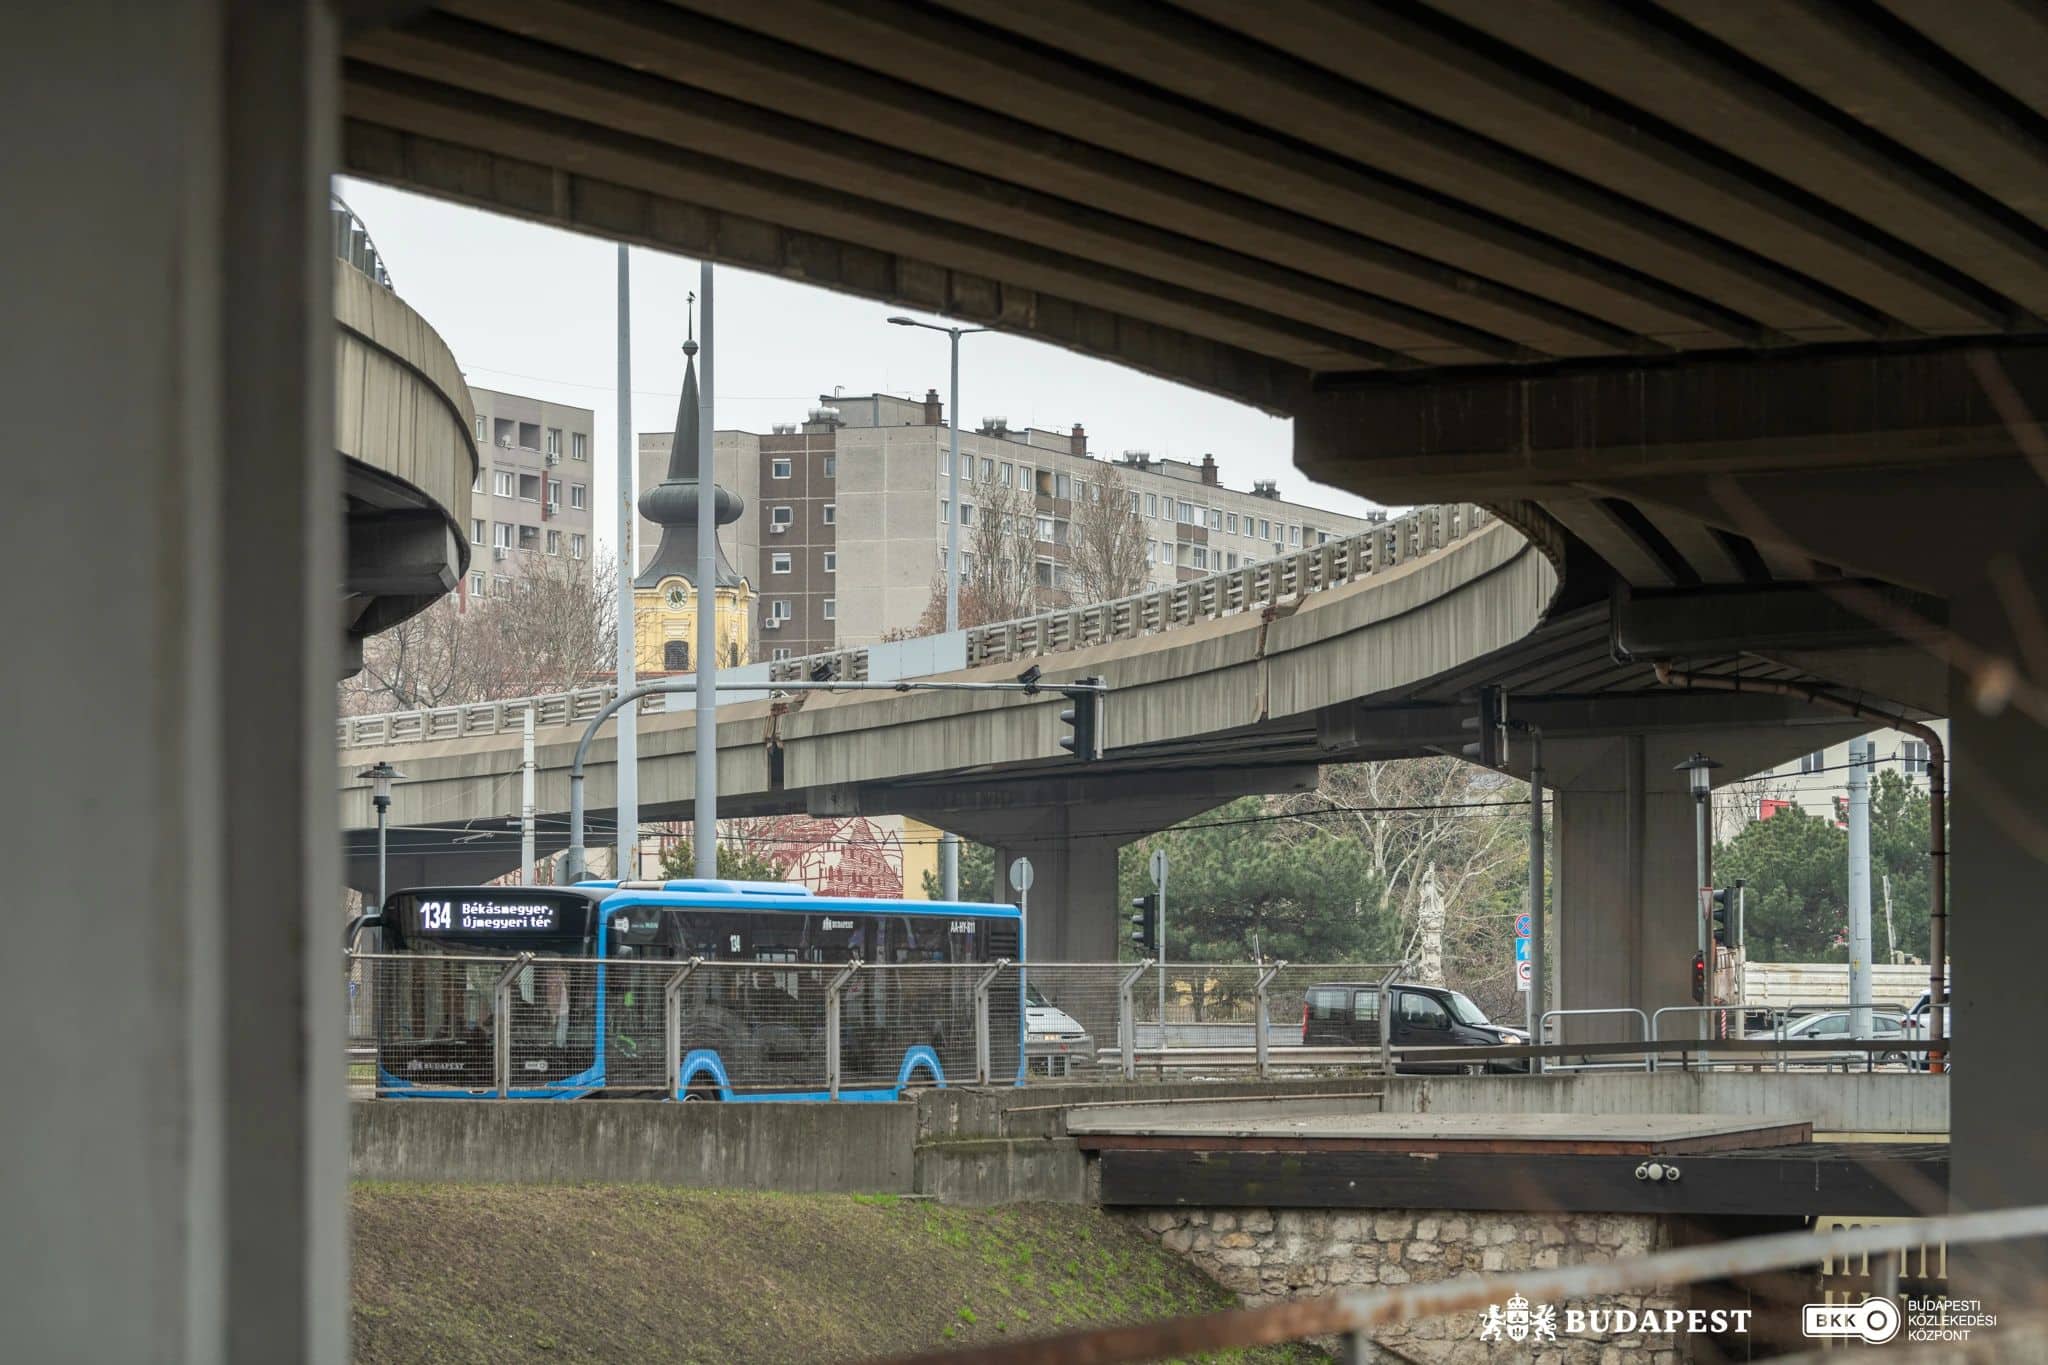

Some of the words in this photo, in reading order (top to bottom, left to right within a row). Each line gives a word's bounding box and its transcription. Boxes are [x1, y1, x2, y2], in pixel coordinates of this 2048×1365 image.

[420, 902, 451, 929] 134
[462, 901, 553, 916] Békásmegyer,
[462, 915, 527, 929] Újmegyeri
[531, 915, 551, 928] tér
[730, 935, 741, 952] 134
